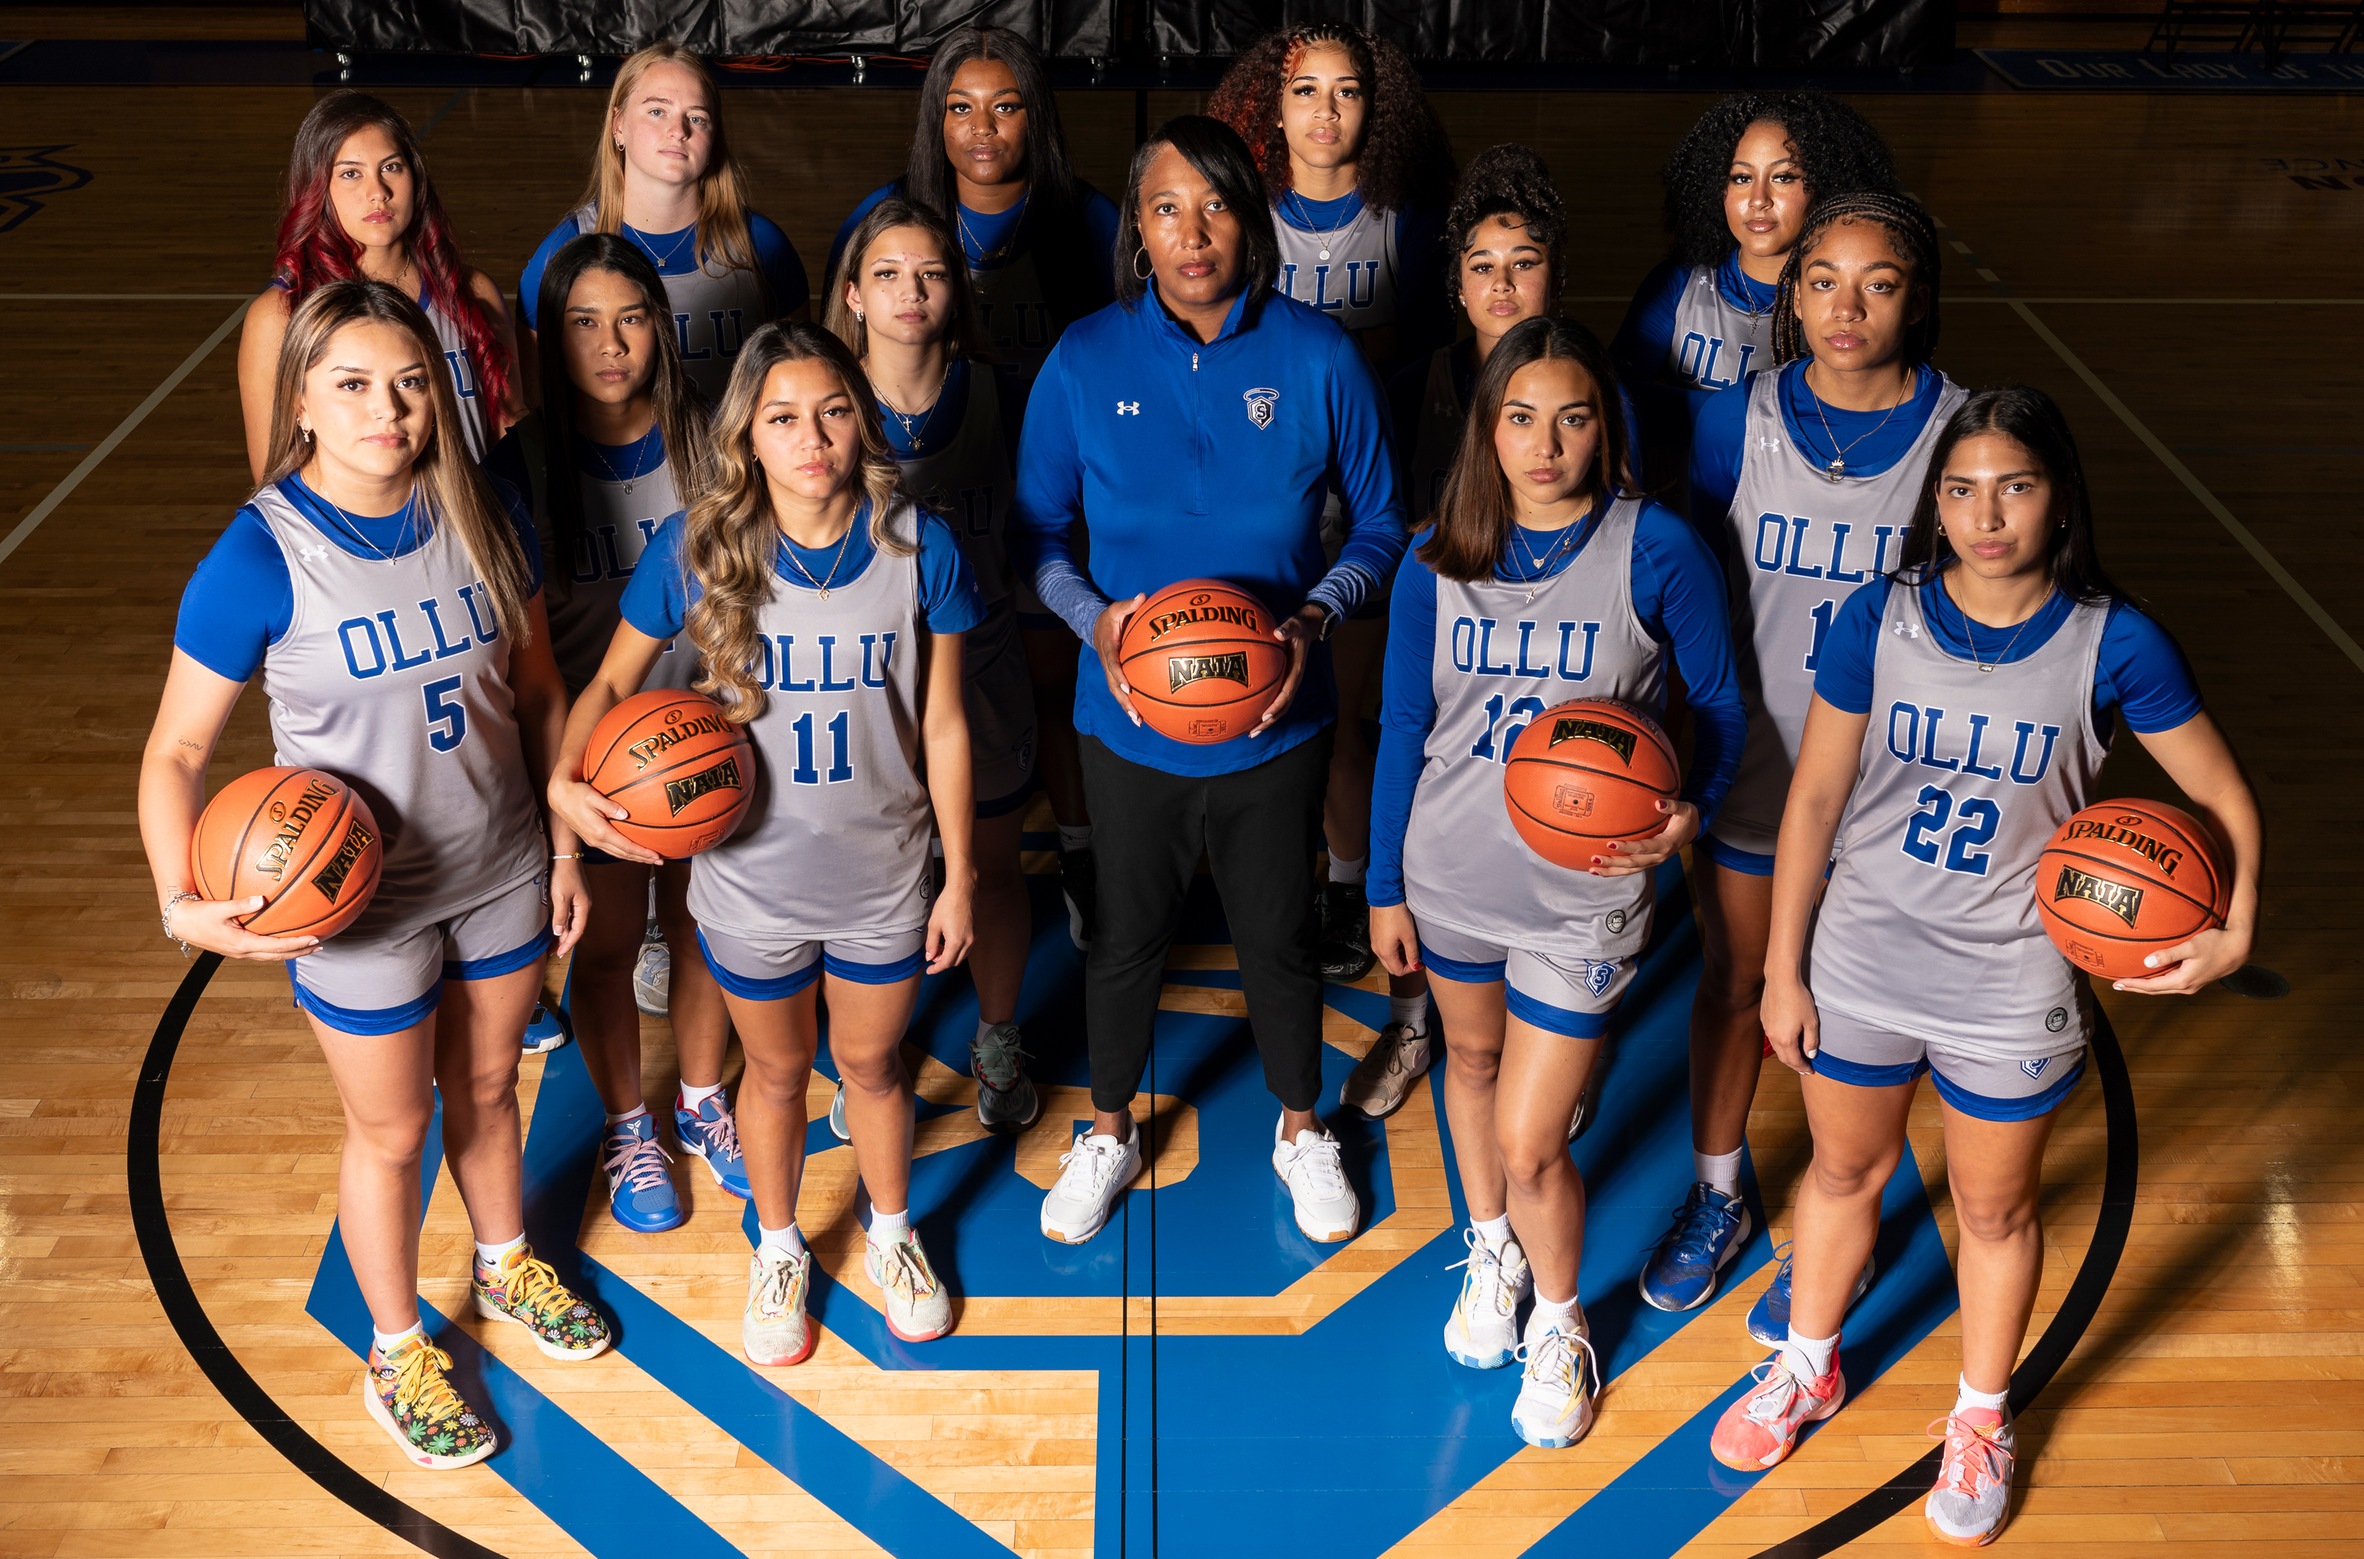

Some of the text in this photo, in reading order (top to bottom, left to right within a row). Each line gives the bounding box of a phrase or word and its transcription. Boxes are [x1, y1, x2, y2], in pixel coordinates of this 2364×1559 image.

[2137, 58, 2247, 79] LADY
[1272, 260, 1379, 309] LLU
[673, 308, 744, 361] LU
[337, 581, 500, 681] OLLU
[1149, 606, 1258, 642] SPALDING
[1452, 615, 1601, 683] OLLU
[1170, 653, 1248, 691] NAIA
[421, 672, 468, 754] 5
[628, 713, 735, 771] SPALDING
[1550, 719, 1635, 765] NAIA
[1886, 699, 2063, 786] OLLU
[790, 709, 855, 786] 11
[666, 757, 740, 815] NAIA
[255, 779, 340, 882] SPALDING
[1900, 783, 2003, 878] 22
[2061, 820, 2184, 877] SPALDING
[314, 819, 373, 902] NAIA
[2057, 867, 2142, 927] NAIA
